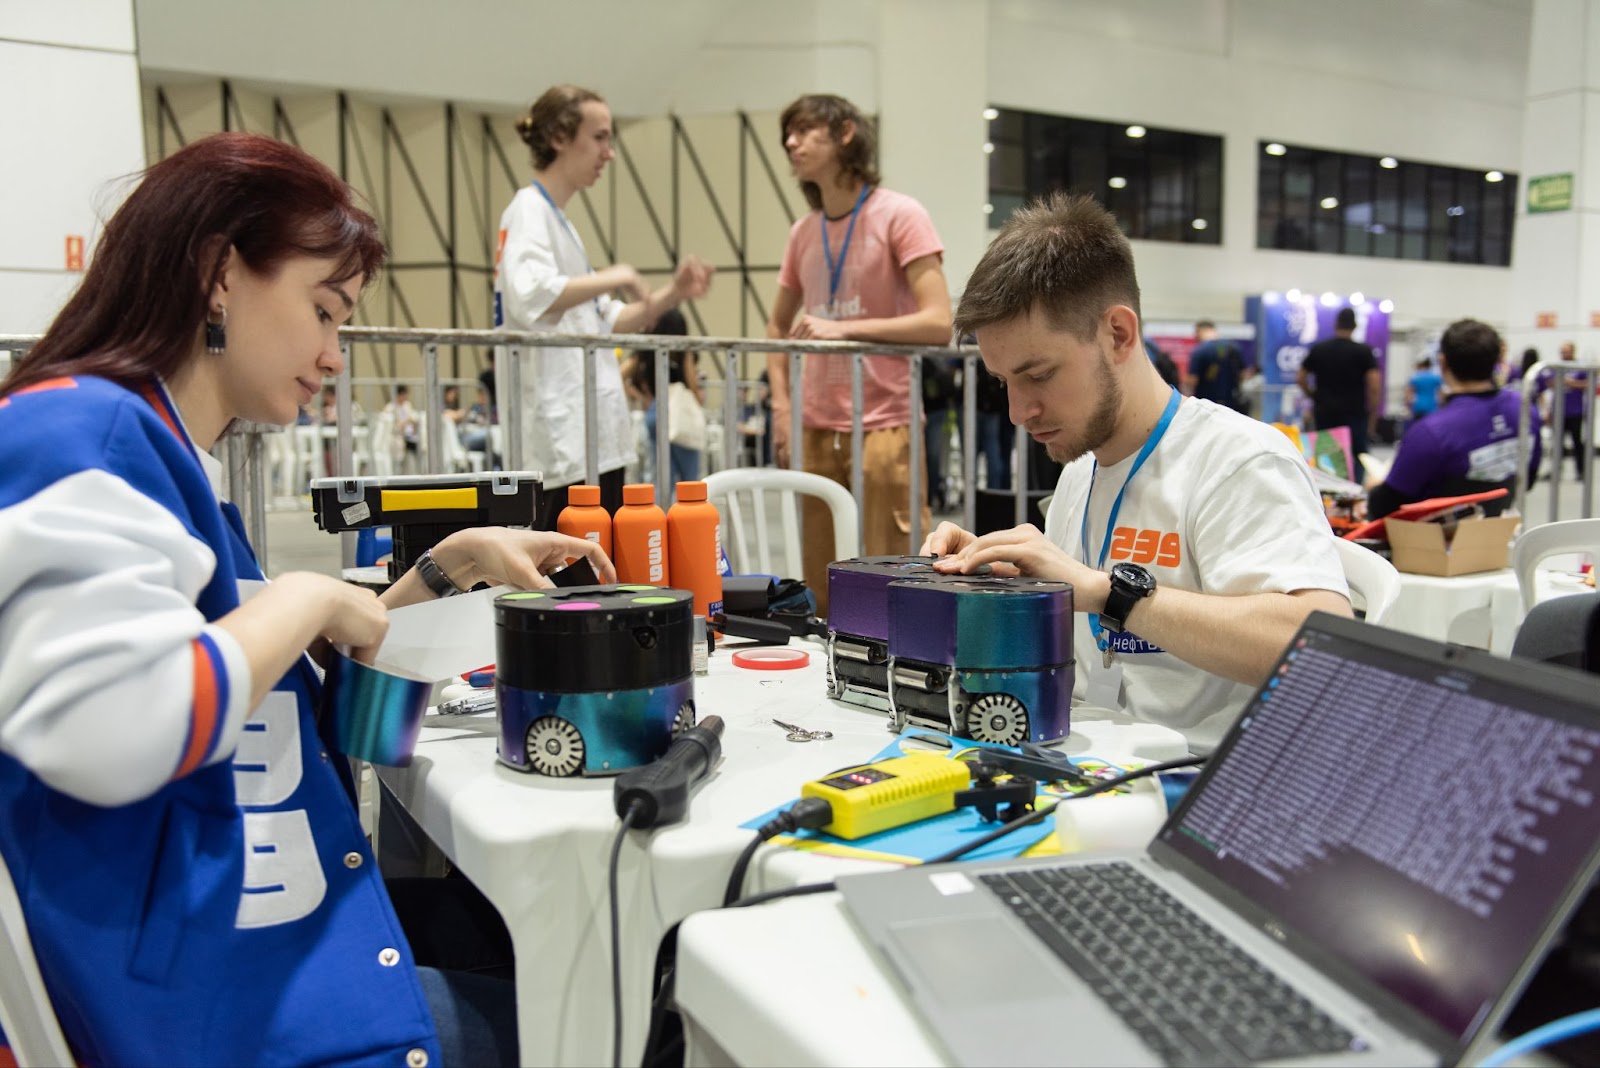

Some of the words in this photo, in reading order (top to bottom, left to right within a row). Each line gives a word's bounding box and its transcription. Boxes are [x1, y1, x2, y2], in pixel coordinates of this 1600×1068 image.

[648, 529, 663, 582] 239
[1110, 526, 1181, 568] 239
[1113, 636, 1158, 654] нефть
